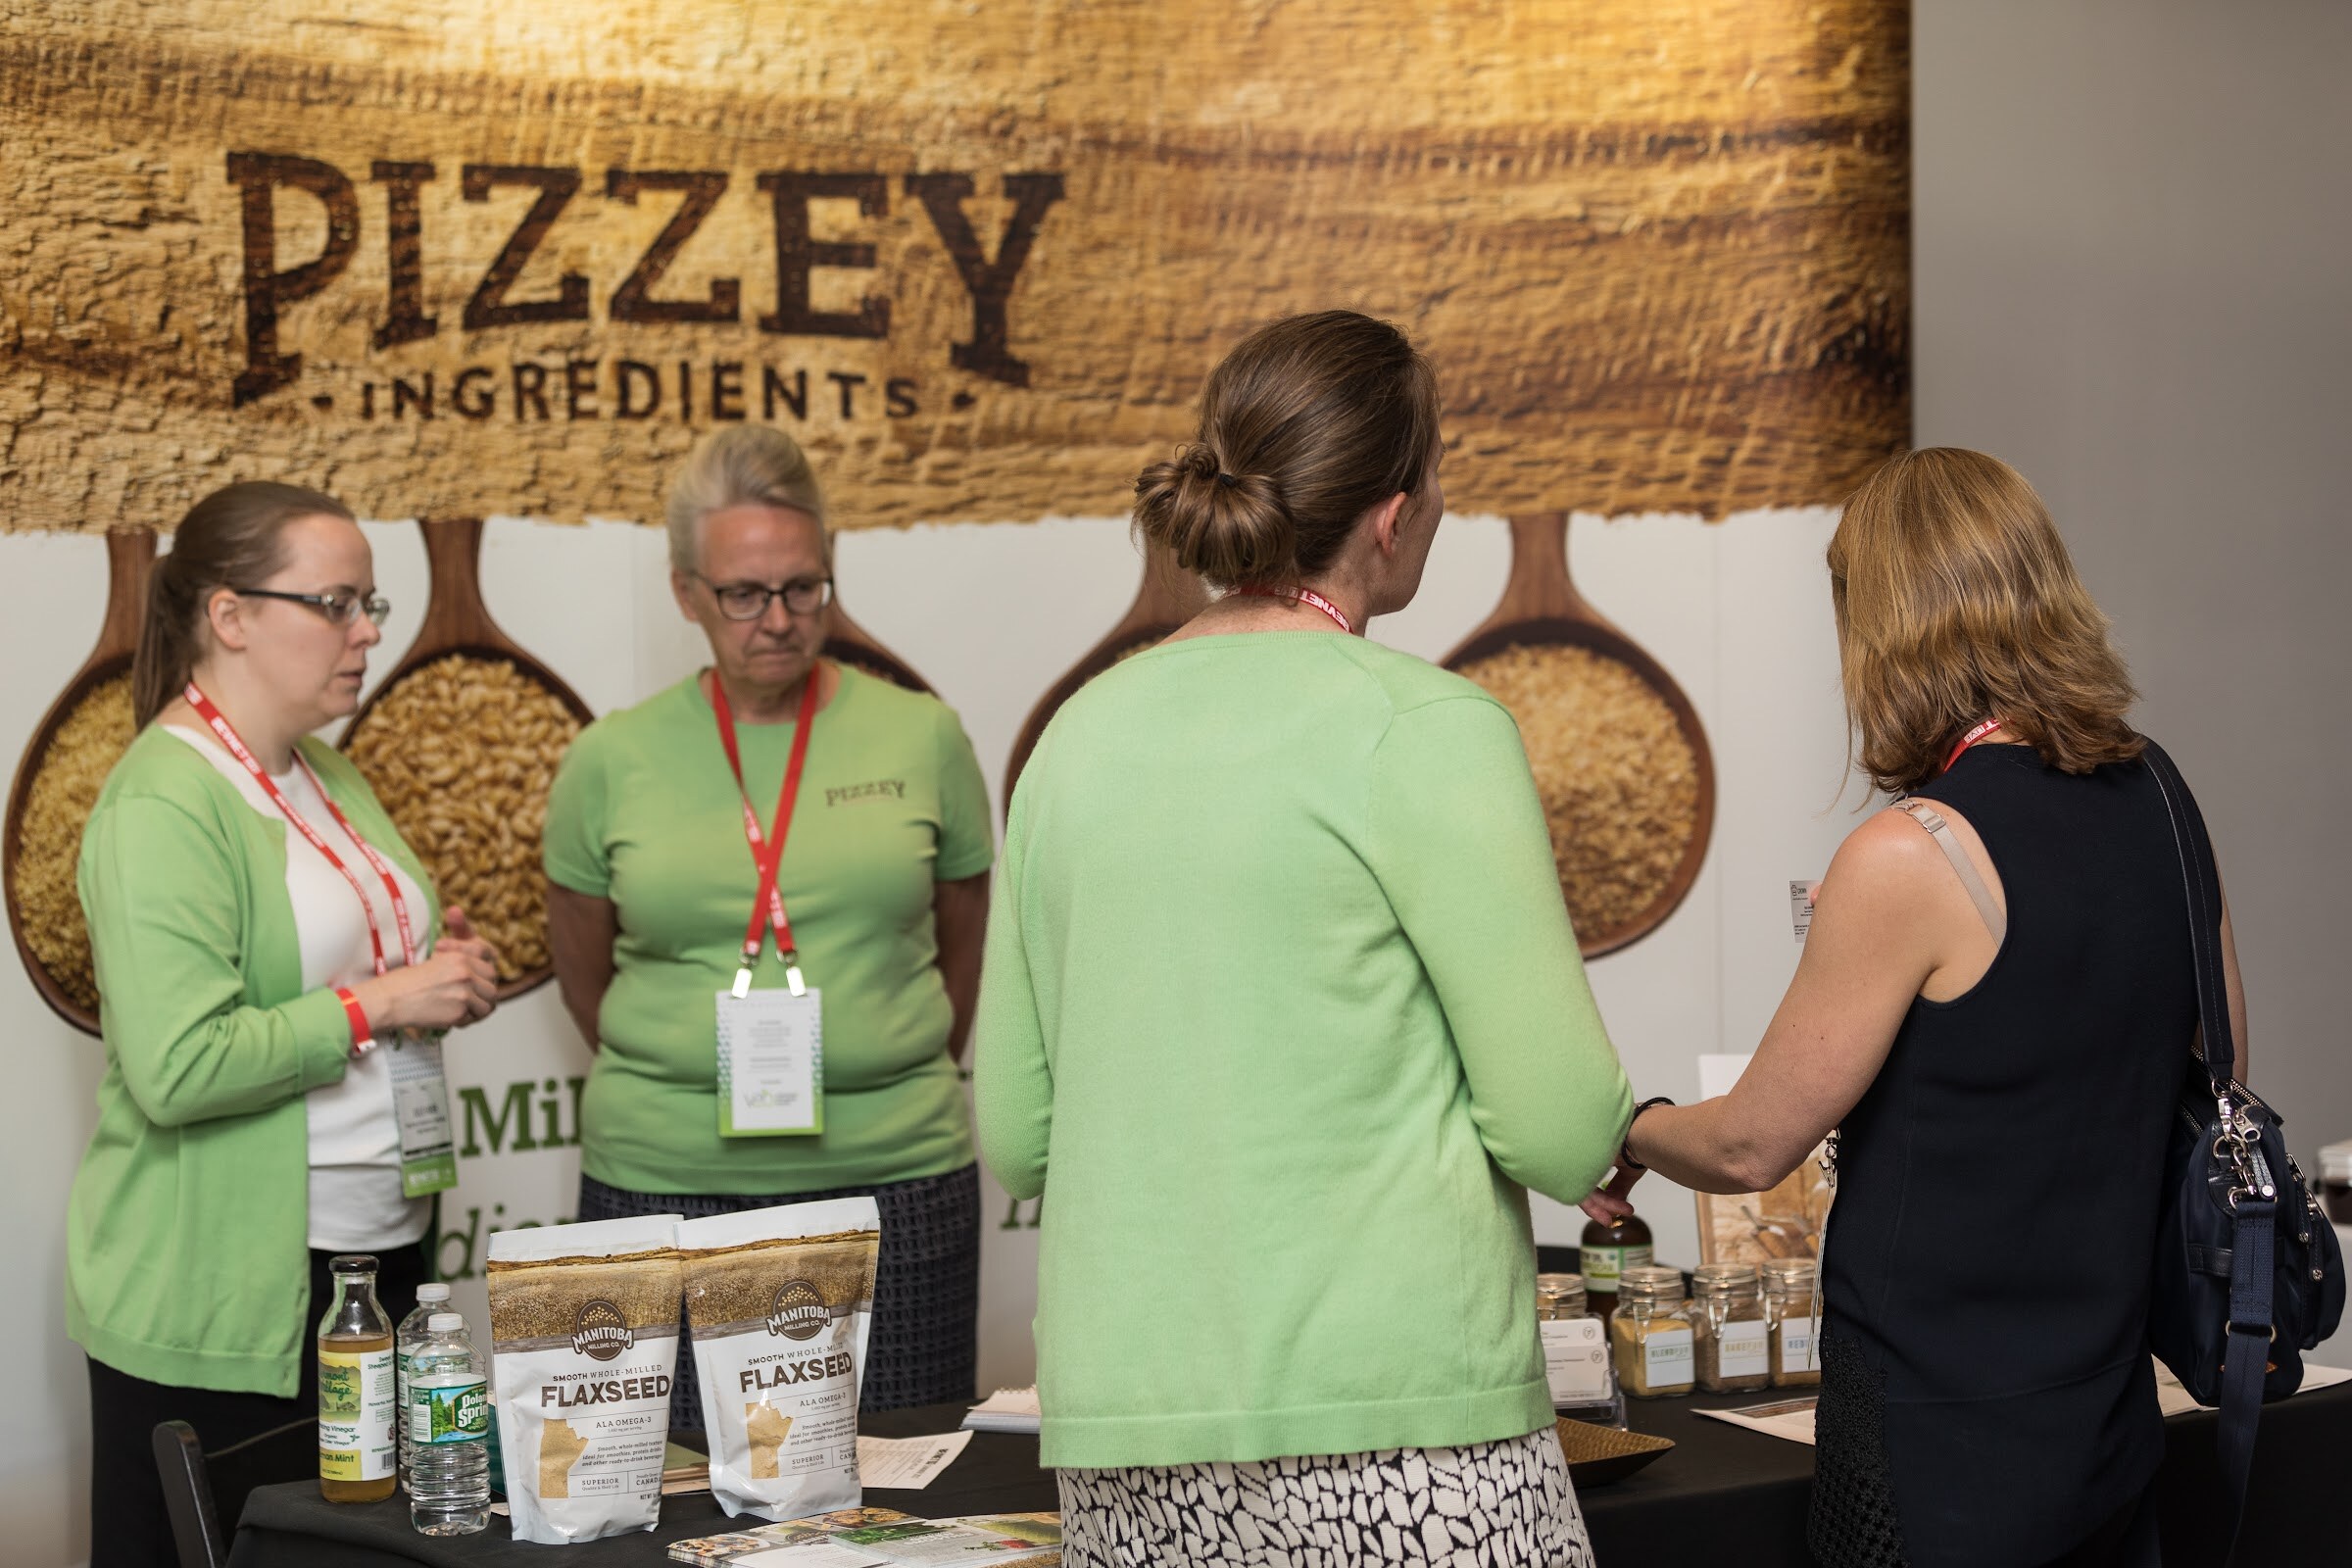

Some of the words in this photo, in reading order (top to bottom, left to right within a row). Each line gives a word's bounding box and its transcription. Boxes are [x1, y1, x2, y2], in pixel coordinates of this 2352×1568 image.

[226, 152, 1064, 407] PIZZEY
[362, 360, 919, 421] INGREDIENTS
[824, 779, 906, 808] PIZZEY
[766, 1305, 831, 1335] MANITOBA
[784, 1322, 809, 1331] MILLING
[572, 1327, 633, 1352] MANITOBA
[748, 1353, 784, 1365] SMOOTH
[553, 1372, 588, 1382] SMOOTH
[590, 1364, 662, 1379] WHOLE-MILLED
[740, 1351, 853, 1393] FLAXSEED
[541, 1375, 670, 1407] FLAXSEED
[800, 1398, 816, 1407] ALA
[818, 1392, 846, 1403] OMEGA-3
[462, 1393, 487, 1409] Polan
[458, 1402, 488, 1428] Sprin
[596, 1420, 614, 1429] ALA
[615, 1416, 652, 1427] OMEGA-3
[335, 1452, 355, 1462] Mint
[792, 1453, 824, 1465] SUPERIOR
[582, 1477, 619, 1486] SUPERIOR
